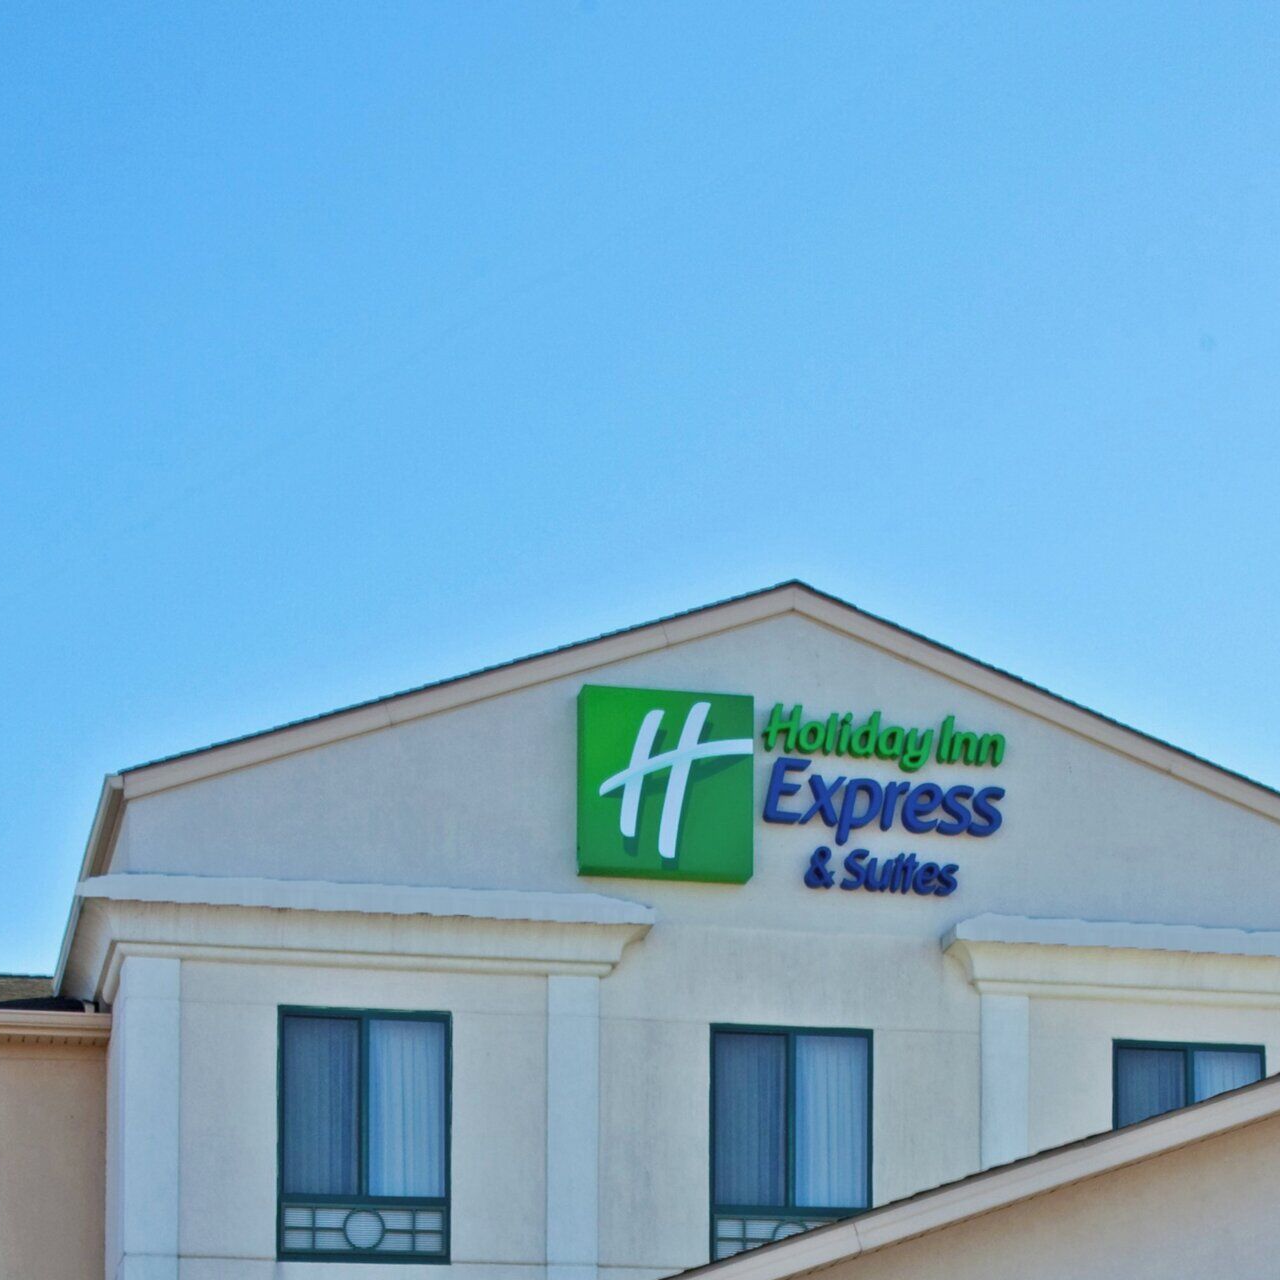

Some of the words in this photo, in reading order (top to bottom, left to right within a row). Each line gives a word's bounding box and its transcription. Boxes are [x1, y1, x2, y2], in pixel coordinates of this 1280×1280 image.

[763, 703, 933, 772] Holiday
[936, 715, 1006, 768] Inn
[599, 702, 753, 859] H
[763, 757, 1006, 845] Express
[803, 846, 835, 889] &
[839, 848, 959, 897] Suites
